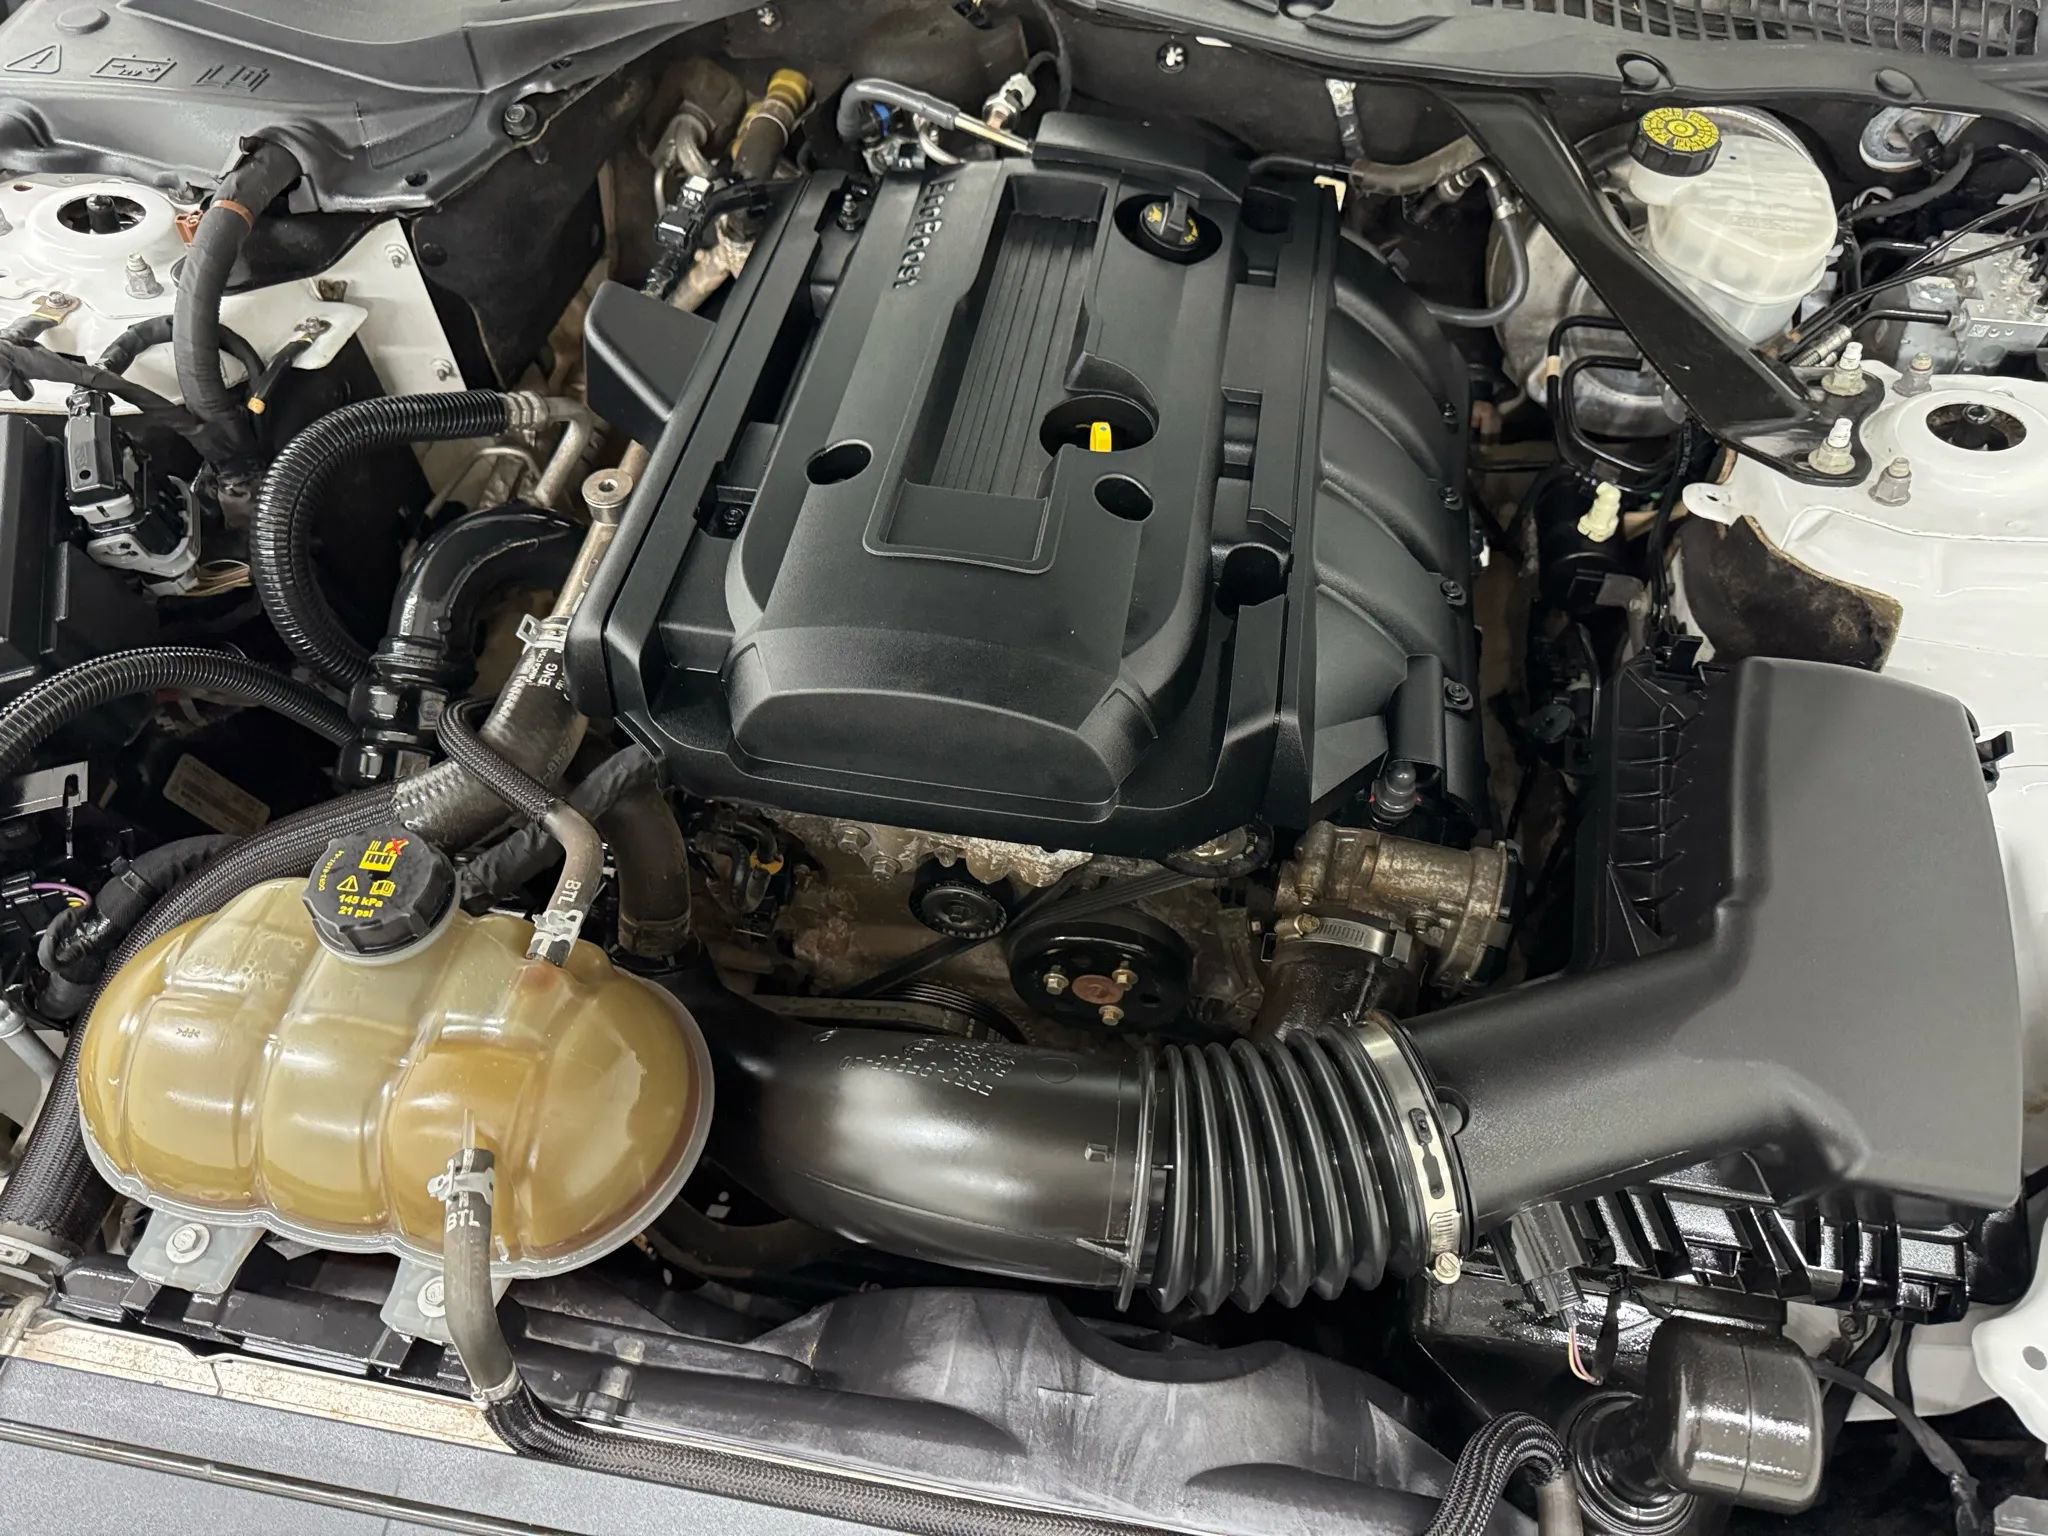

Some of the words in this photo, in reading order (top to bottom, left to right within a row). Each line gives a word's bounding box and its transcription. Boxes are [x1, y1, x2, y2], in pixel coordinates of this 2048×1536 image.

[537, 662, 559, 687] ENG
[338, 894, 360, 905] 145
[361, 897, 384, 907] kPa
[557, 879, 582, 905] BTL
[338, 906, 354, 916] 21
[355, 909, 374, 919] psi
[446, 1208, 481, 1233] BTL
